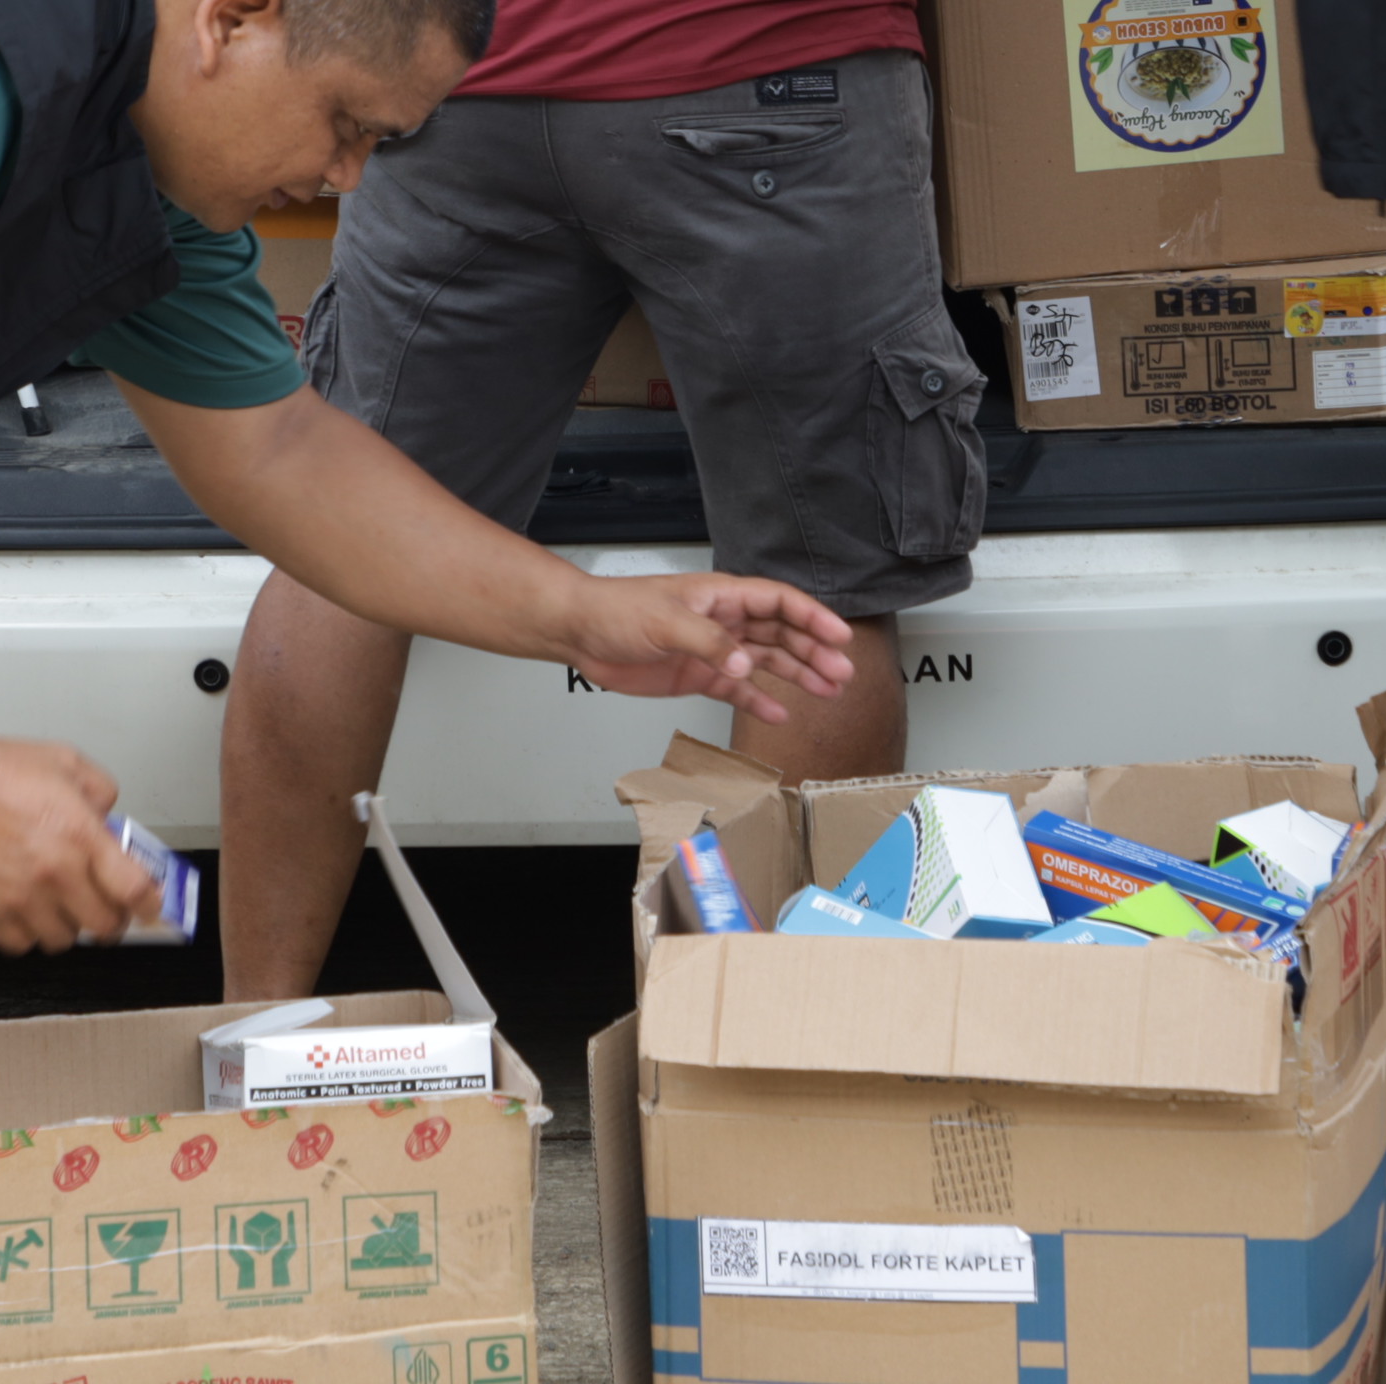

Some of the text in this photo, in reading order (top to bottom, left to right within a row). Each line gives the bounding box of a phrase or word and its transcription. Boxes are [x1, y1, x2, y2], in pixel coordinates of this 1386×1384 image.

[1116, 15, 1226, 40] BUBUR SEDUH
[1168, 104, 1231, 126] Kacang
[1144, 320, 1270, 334] KONDISI SUHU PENYIMPANAN
[1145, 399, 1168, 414] ISI
[1185, 398, 1206, 412] 60
[1211, 395, 1276, 412] BOTOL
[1042, 852, 1150, 895] OMEPRAZOL
[1055, 874, 1084, 891] KAPSUL
[1085, 884, 1109, 899] LEPAS
[335, 1042, 426, 1064] Altamed
[285, 1065, 448, 1083] STERILE LATEX SURGICAL GLOVES
[252, 1087, 307, 1101] Anatomic
[320, 1084, 349, 1097] Palm
[353, 1081, 402, 1095] Textured
[415, 1078, 458, 1091] Powder
[461, 1076, 484, 1089] Free
[778, 1251, 1025, 1273] FASIDOL FORTE KAPLET
[486, 1343, 510, 1372] 6
